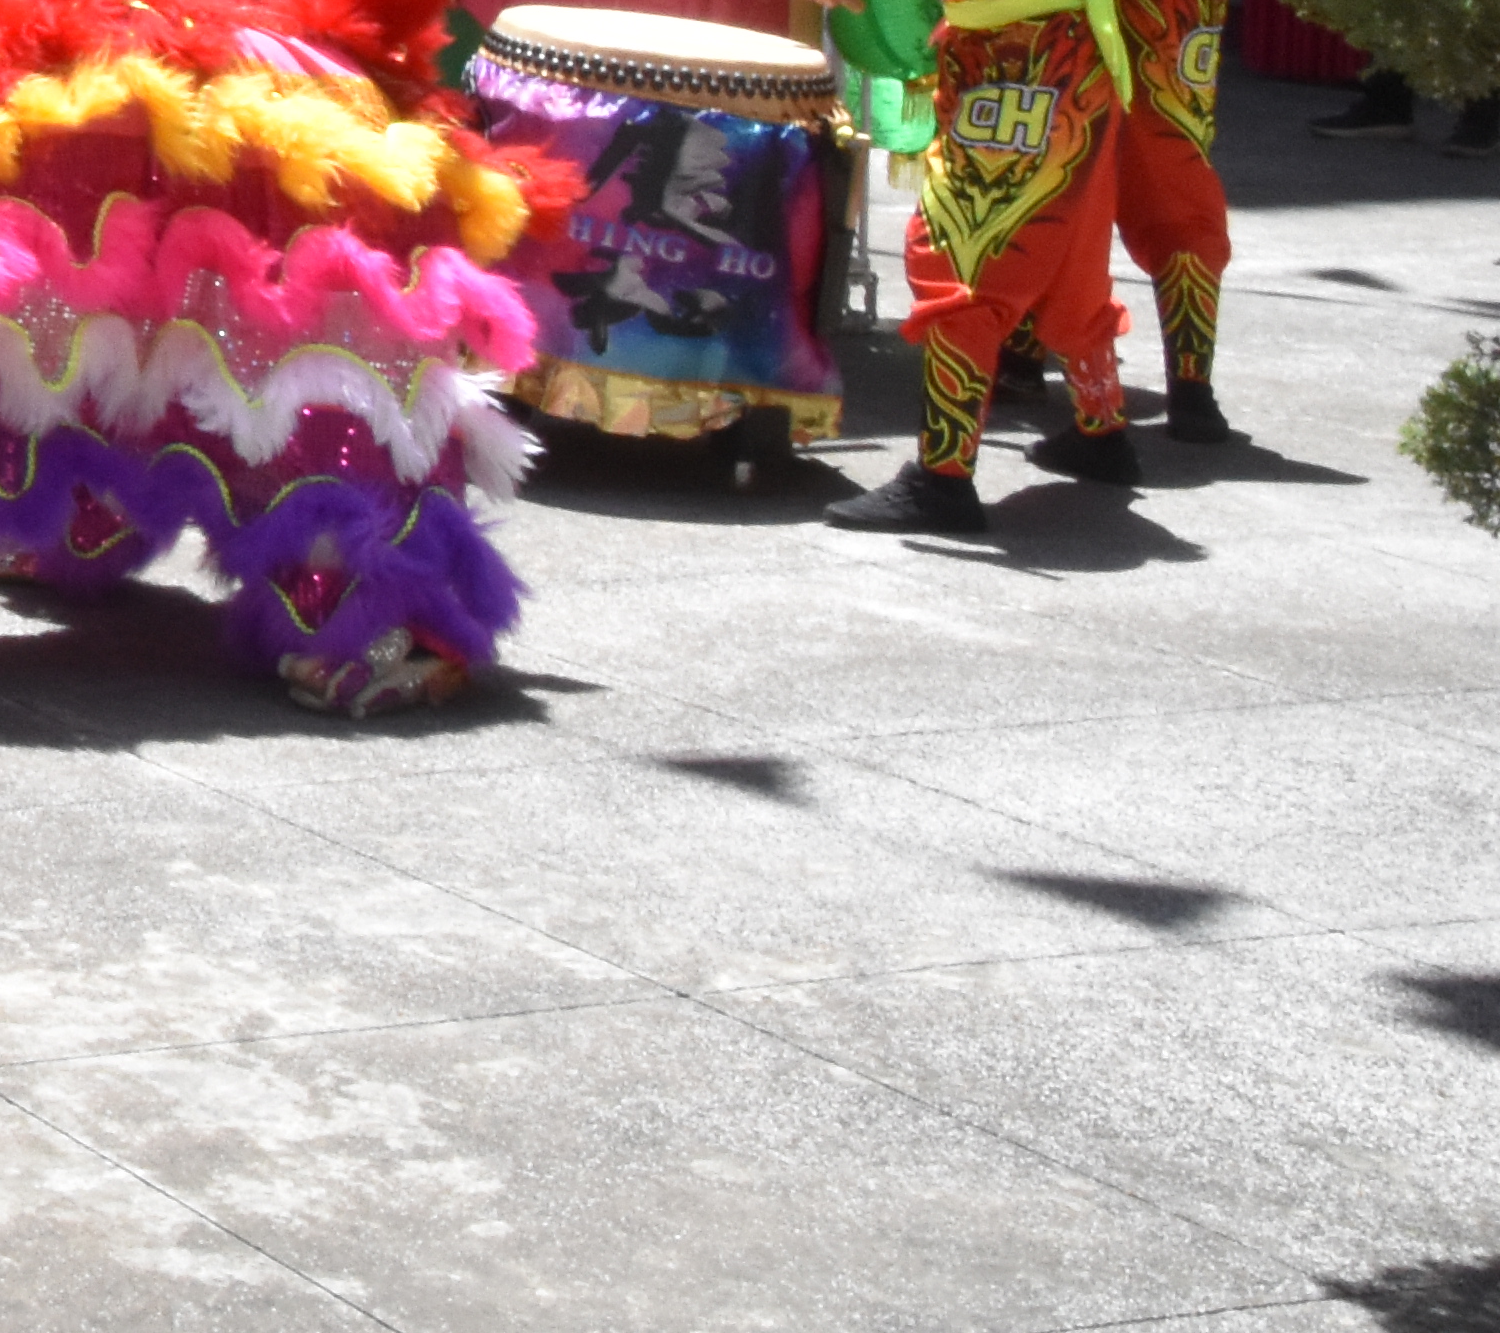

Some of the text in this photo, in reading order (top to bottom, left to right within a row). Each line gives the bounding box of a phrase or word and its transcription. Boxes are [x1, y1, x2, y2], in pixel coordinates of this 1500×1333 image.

[952, 83, 1057, 153] CH
[566, 215, 777, 281] HING HO
